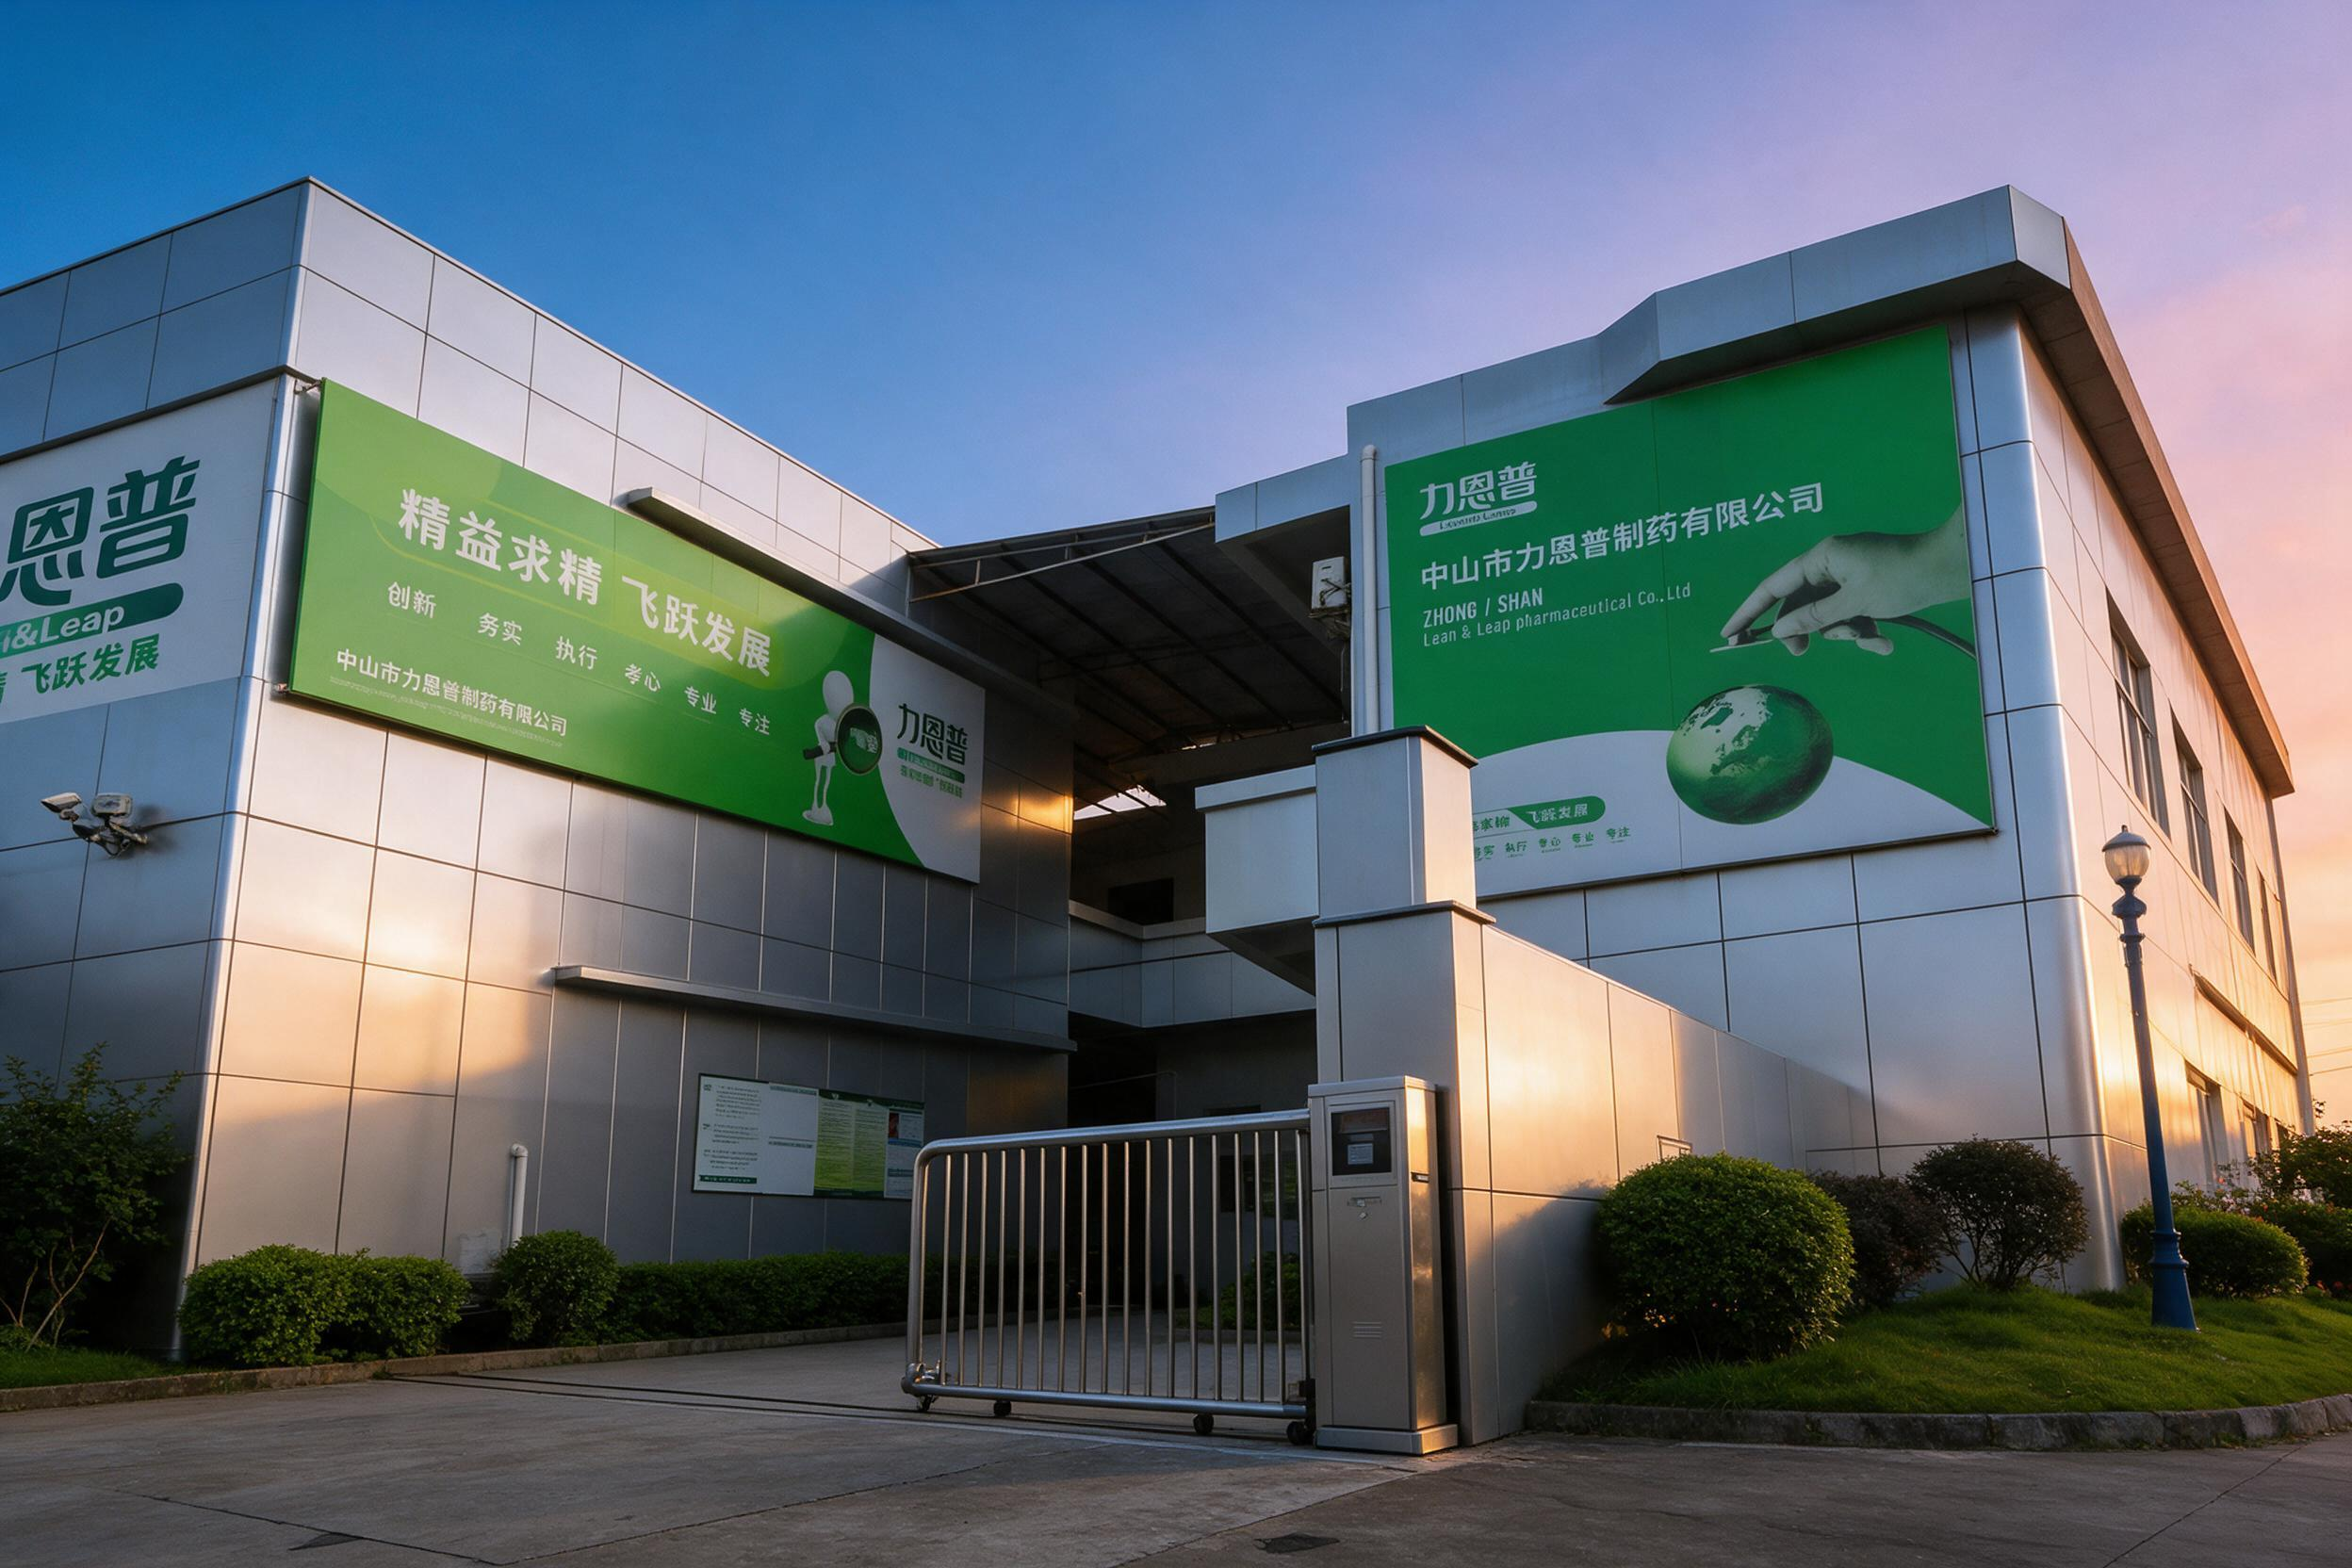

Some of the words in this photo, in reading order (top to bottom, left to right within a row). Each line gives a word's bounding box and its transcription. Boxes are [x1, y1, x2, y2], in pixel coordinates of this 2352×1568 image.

[1418, 460, 1538, 520] 力恩普
[1420, 482, 1824, 591] 中山市力恩普制药有限公司
[398, 487, 603, 606] 精益求精
[621, 574, 772, 678] 飞跃发展
[1423, 600, 1478, 629] ZHONG
[1497, 587, 1544, 613] SHAN
[1424, 629, 1458, 647] Lean
[1462, 625, 1471, 639] &
[1477, 618, 1511, 637] Leap
[1515, 593, 1632, 631] pharmaceutical
[21, 632, 160, 694] 飞跃发展
[387, 580, 437, 619] 创新
[477, 612, 523, 646] 务实
[555, 635, 598, 671] 执行
[684, 686, 717, 715] 专业
[739, 708, 771, 736] 专注
[335, 647, 568, 737] 中山市力恩普制药有限公司
[897, 702, 969, 766] 力恩普
